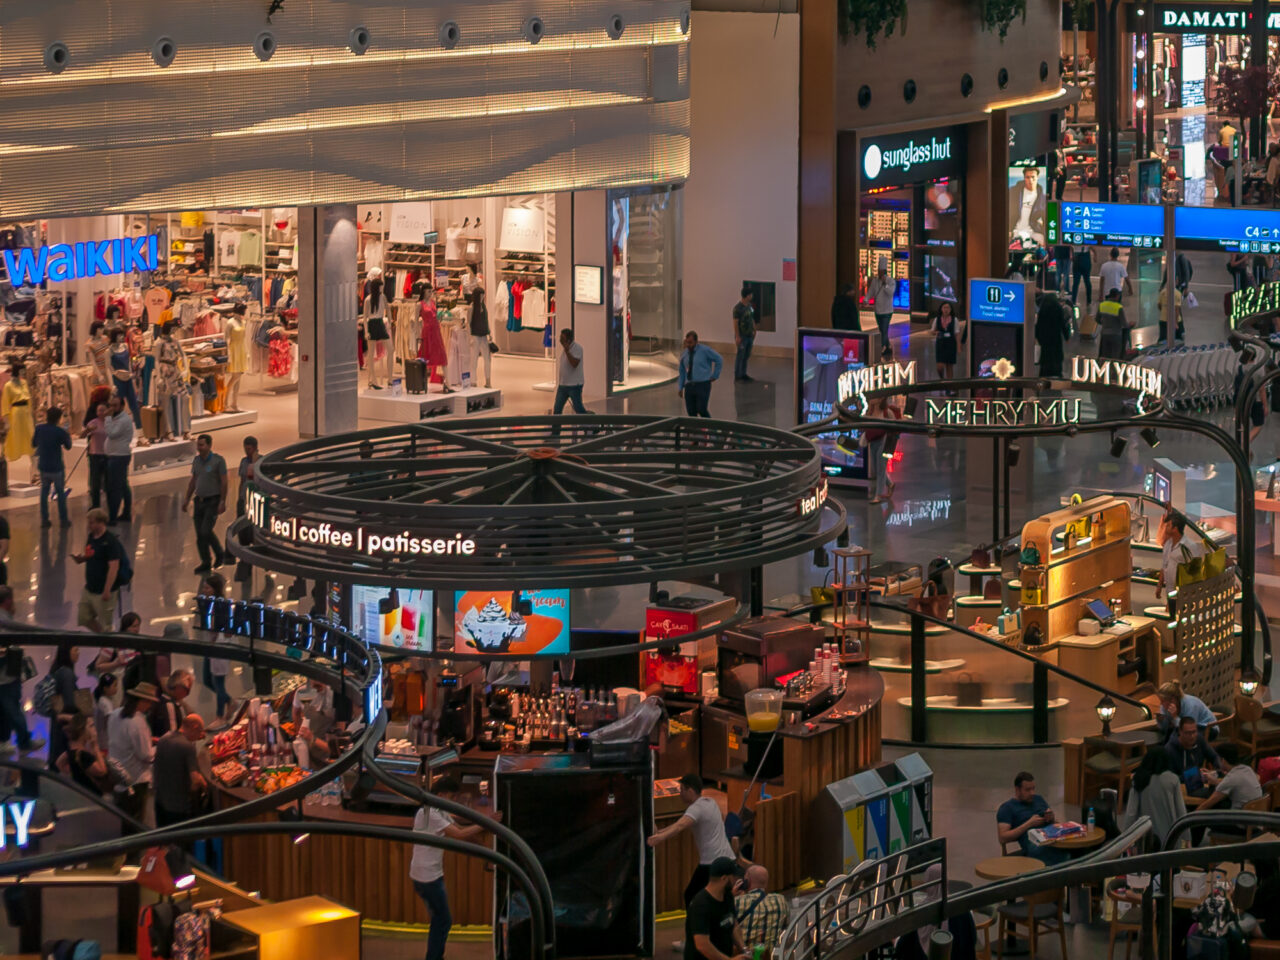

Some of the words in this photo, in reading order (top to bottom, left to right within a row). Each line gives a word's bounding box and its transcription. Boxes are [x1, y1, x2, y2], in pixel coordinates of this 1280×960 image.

[1164, 11, 1239, 27] DAMAT
[882, 140, 930, 172] sunglass
[931, 137, 951, 160] hut
[1083, 206, 1091, 217] A
[1083, 219, 1090, 230] B
[1245, 226, 1260, 238] C4
[925, 398, 1028, 426] MEHRY
[1034, 397, 1082, 426] MU
[801, 497, 816, 516] tea
[270, 515, 290, 537] tea
[299, 522, 353, 547] coffee
[368, 530, 476, 556] patisserie
